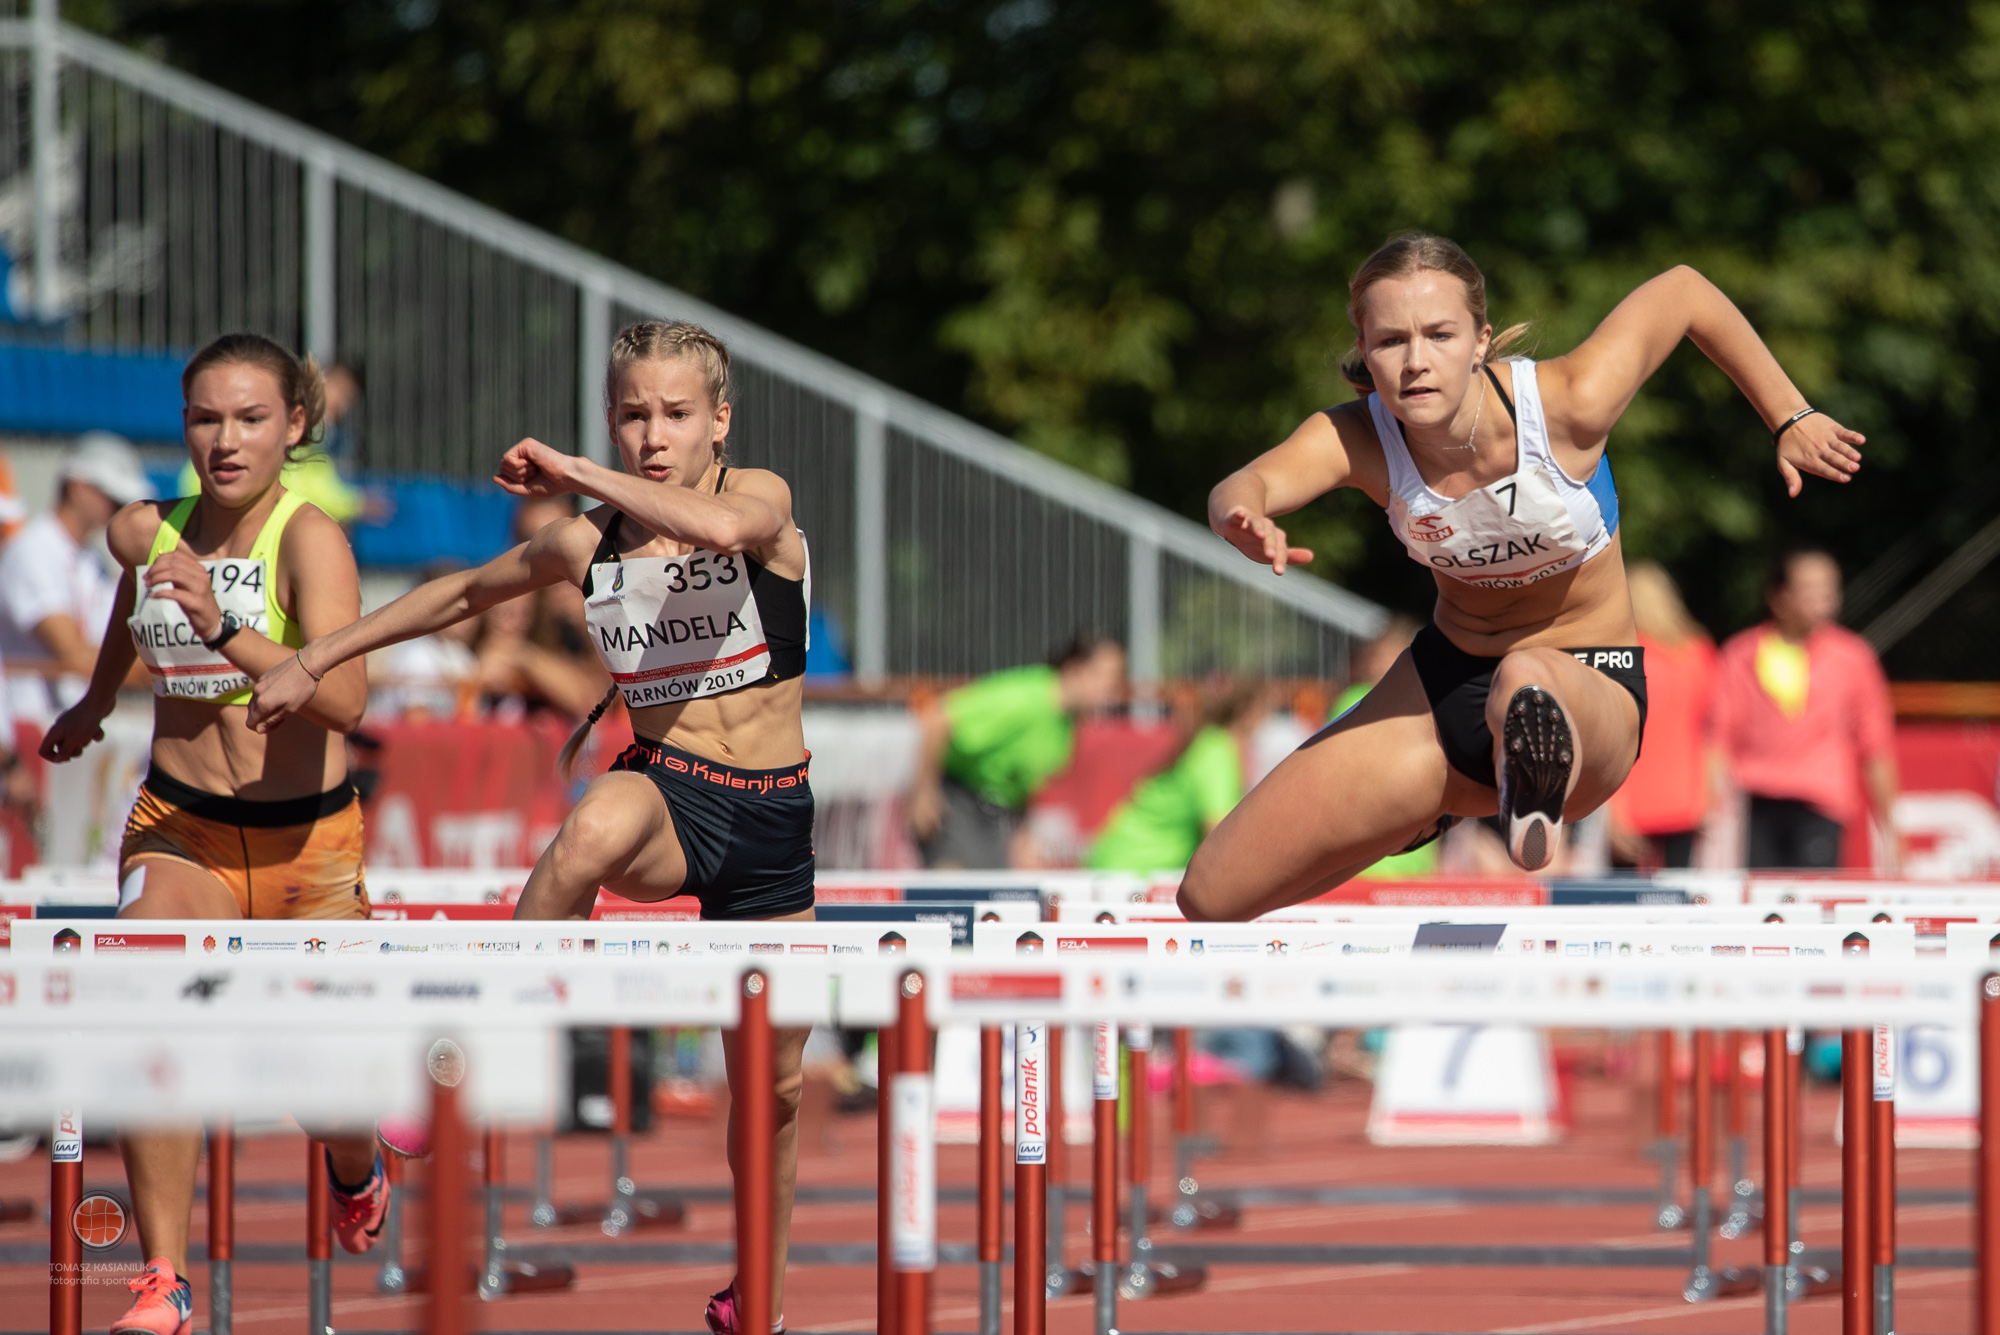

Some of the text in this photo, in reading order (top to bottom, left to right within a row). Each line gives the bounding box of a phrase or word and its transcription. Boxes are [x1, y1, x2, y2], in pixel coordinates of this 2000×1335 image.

[1495, 482, 1517, 517] 7
[1430, 533, 1551, 569] OLSZAK
[663, 553, 739, 594] 353
[600, 611, 747, 652] MANDELA
[1594, 650, 1634, 669] PRO
[163, 676, 250, 696] ARNÓW 2019
[623, 669, 746, 704] TARNÓW 2019
[692, 761, 774, 795] Kalenji
[97, 936, 127, 946] PZLA
[709, 942, 742, 951] Kantoria
[832, 944, 862, 954] Tarnów
[1021, 1058, 1041, 1137] polanik
[55, 1143, 79, 1152] IAAF
[1020, 1145, 1043, 1154] IAAF
